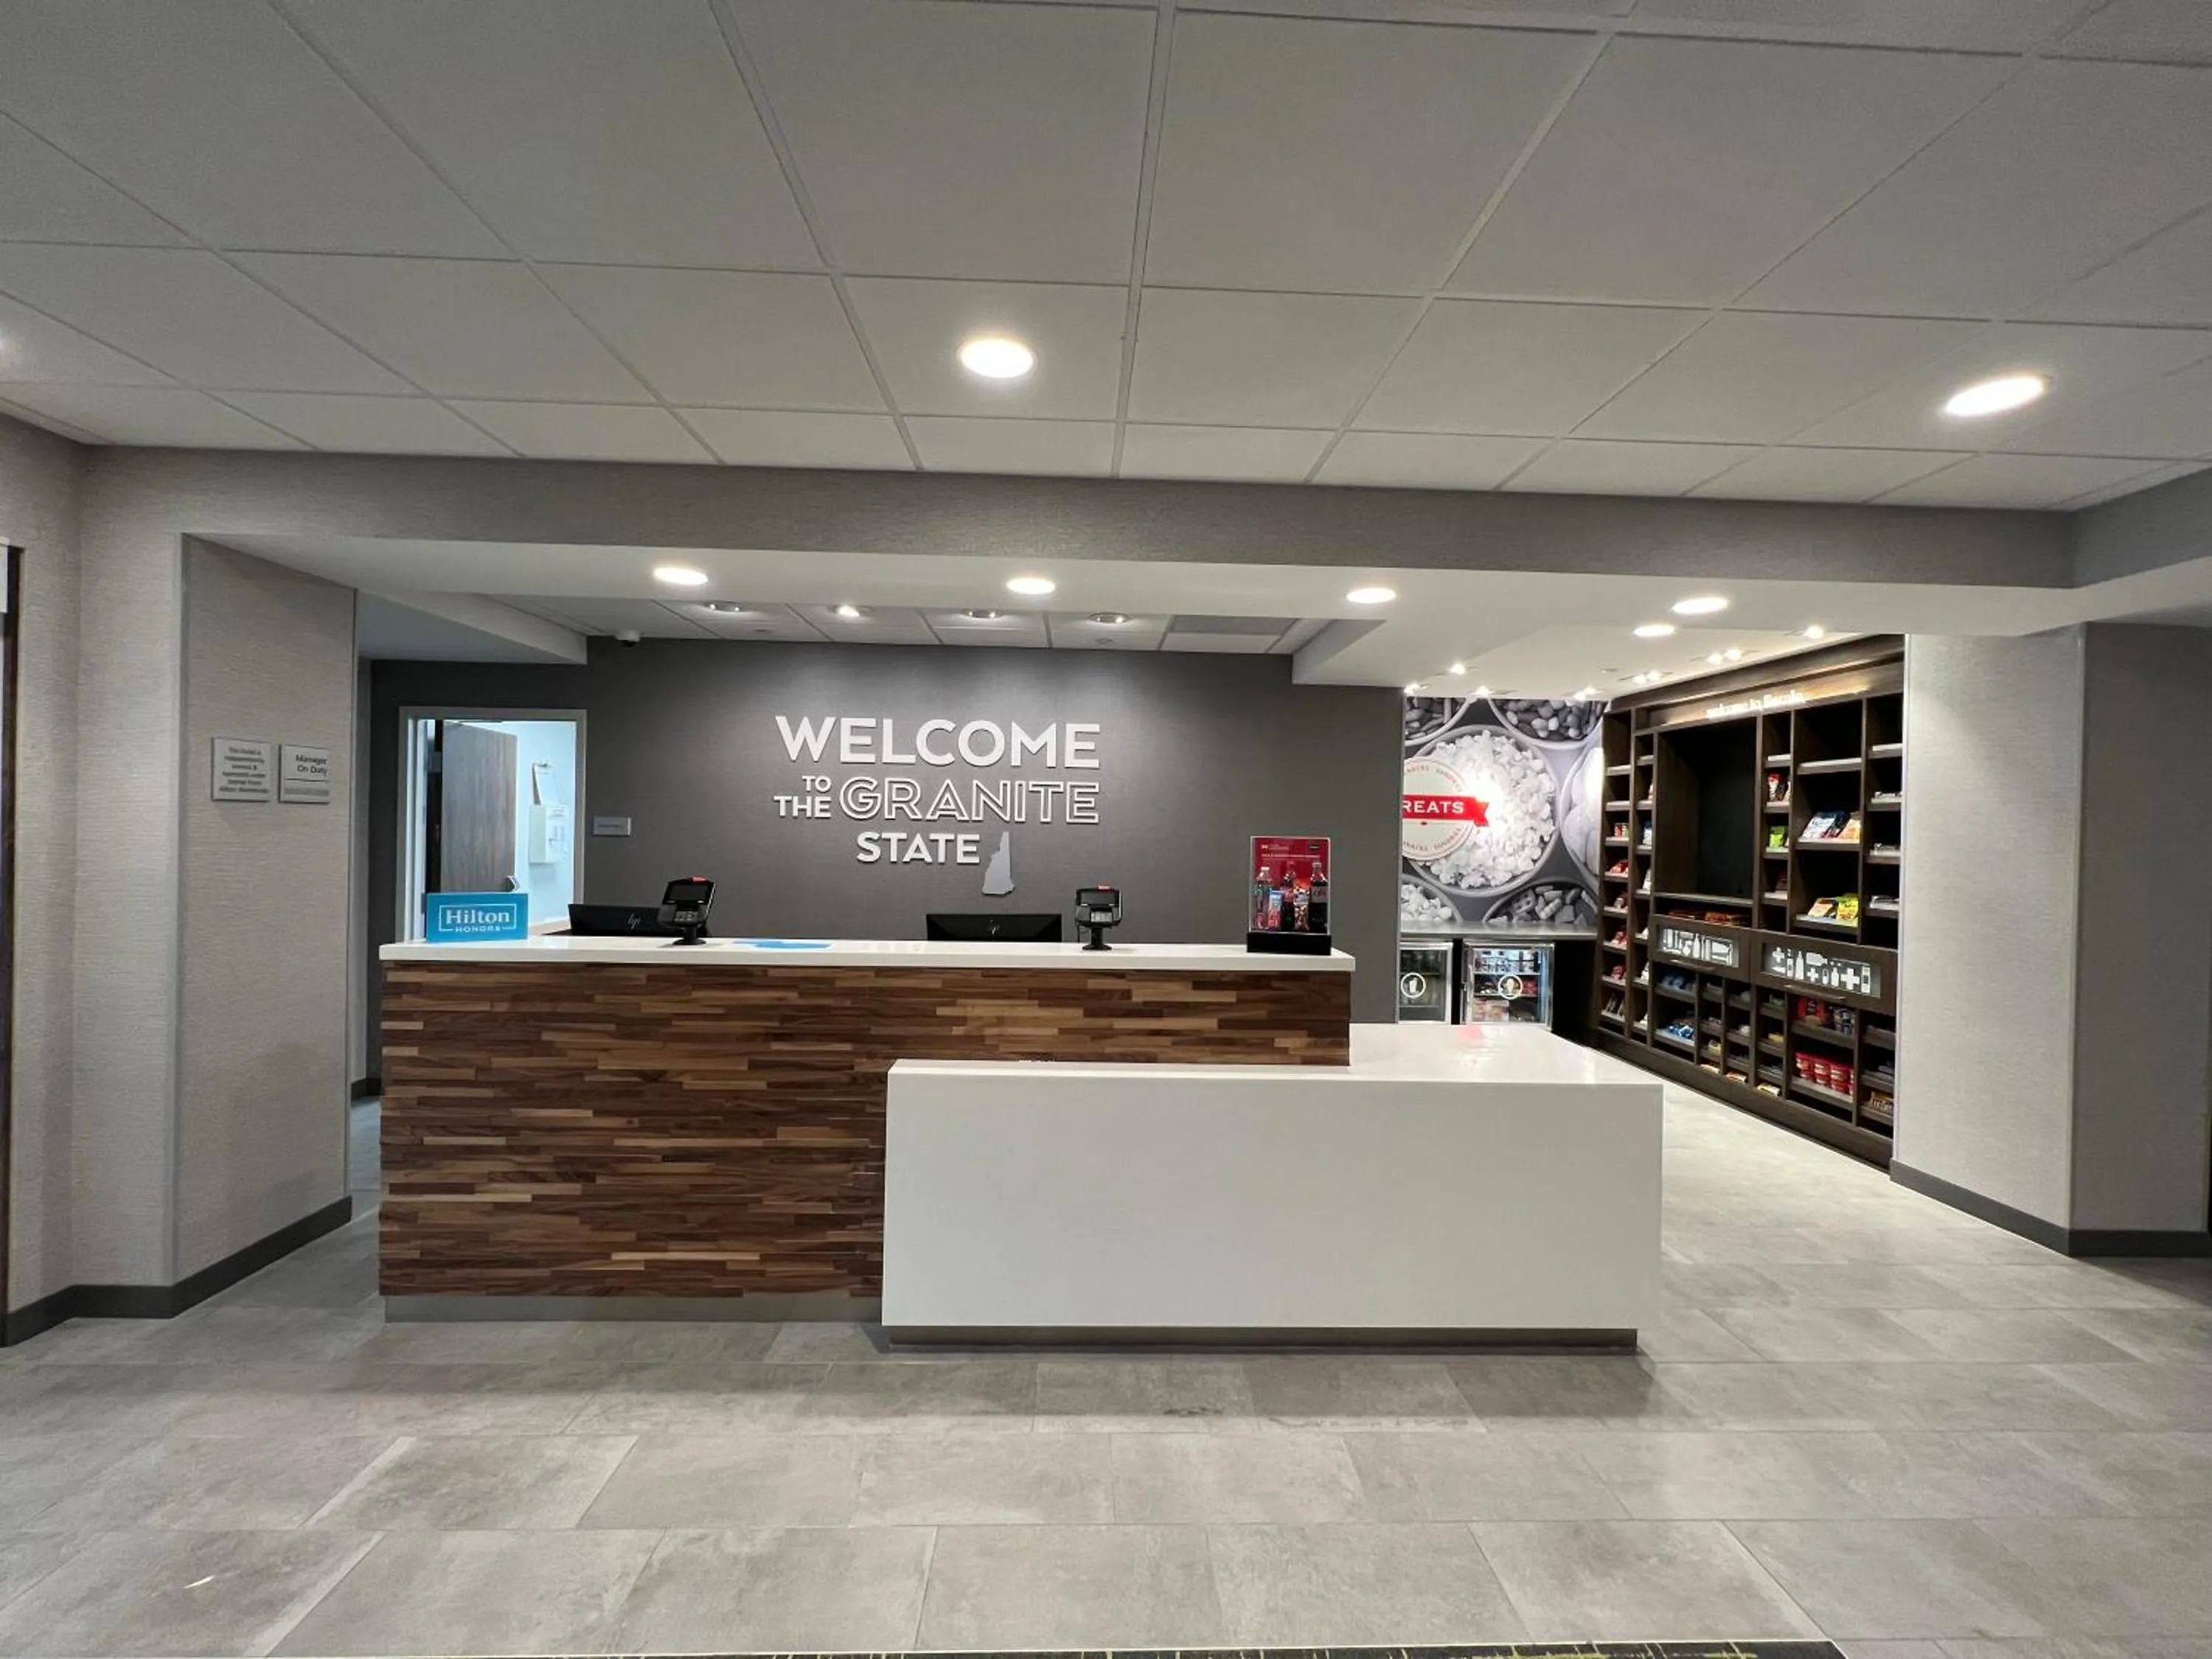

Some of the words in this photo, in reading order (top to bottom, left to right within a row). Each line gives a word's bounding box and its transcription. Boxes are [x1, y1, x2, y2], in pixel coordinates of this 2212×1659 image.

[775, 715, 1100, 768] WELCOME
[296, 754, 327, 765] Manager
[297, 765, 308, 773] On
[310, 765, 327, 776] Duty
[802, 775, 832, 793] TO
[774, 795, 832, 818] THE
[839, 776, 1100, 824] GRANITE
[856, 831, 980, 864] STATE
[445, 909, 510, 925] Hilton
